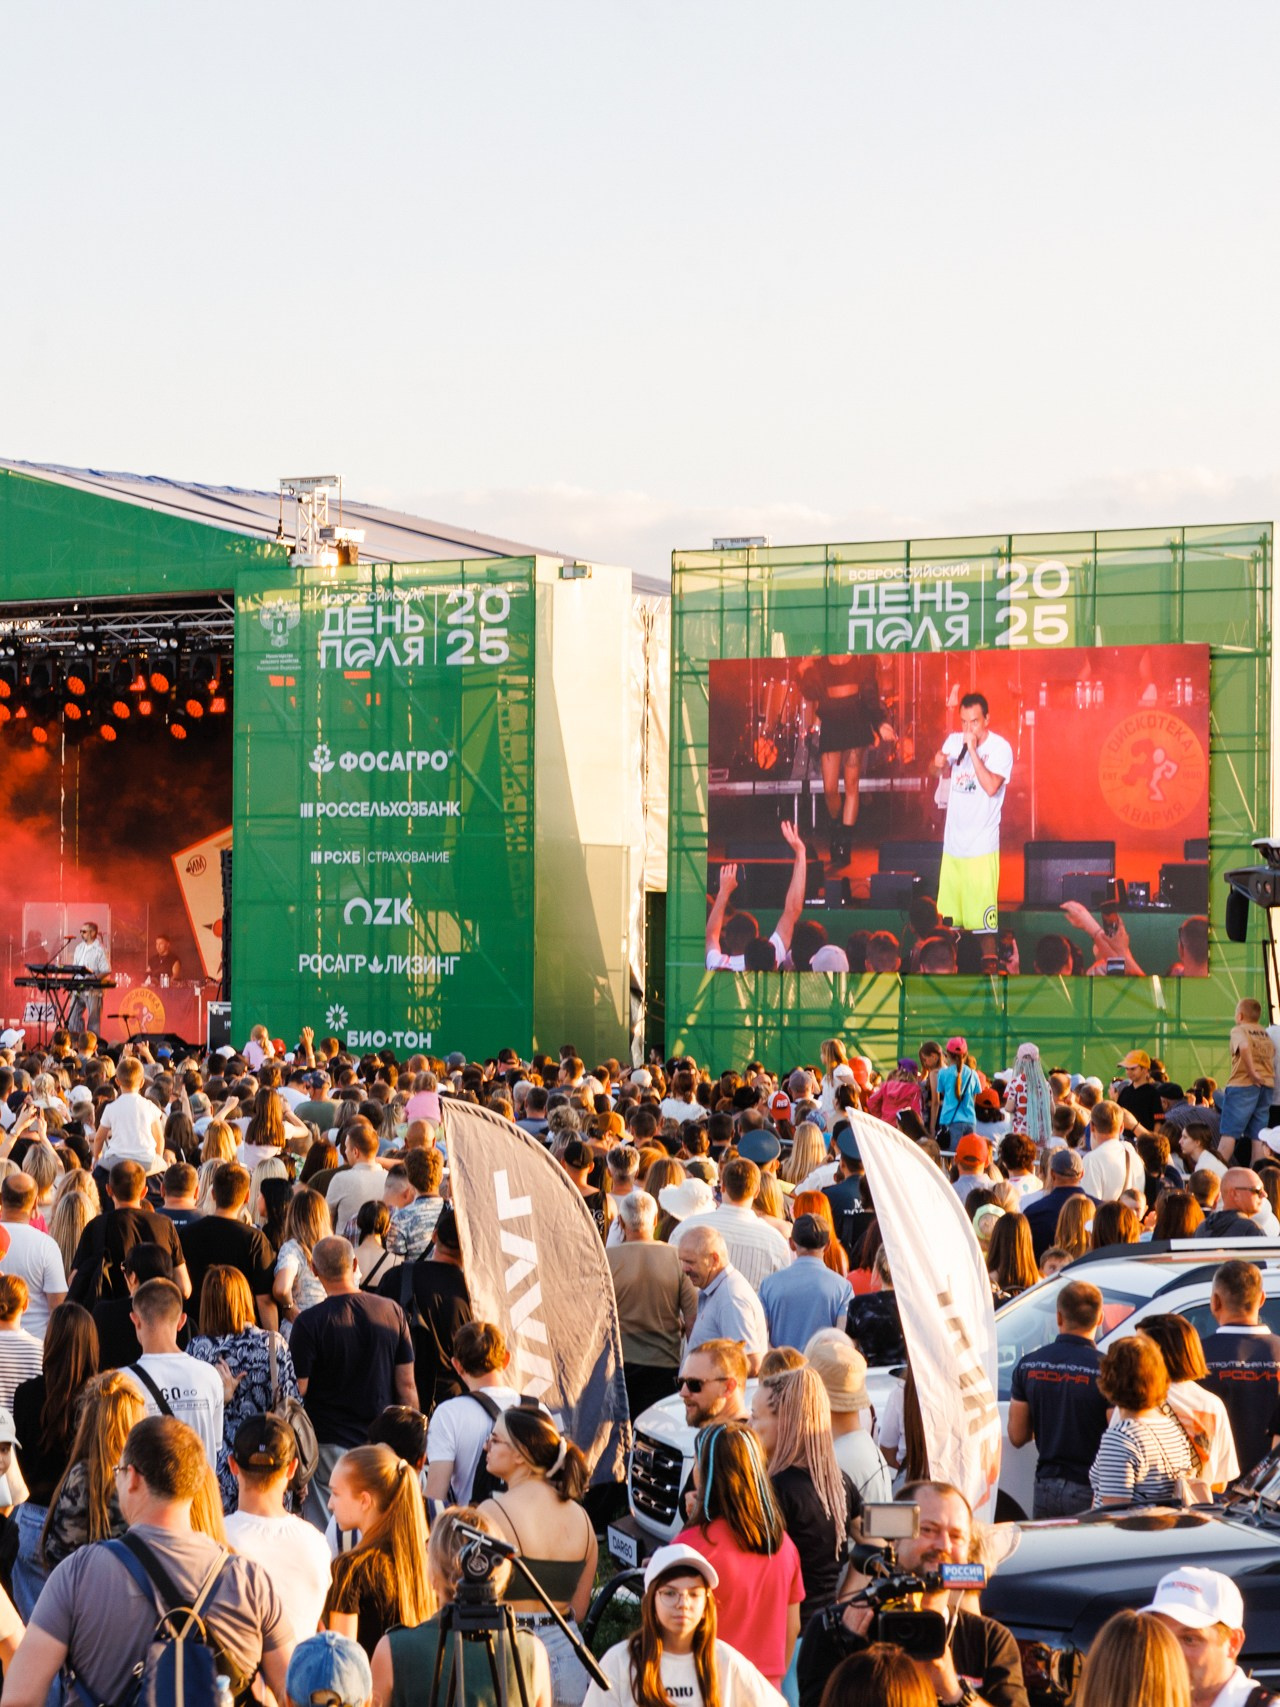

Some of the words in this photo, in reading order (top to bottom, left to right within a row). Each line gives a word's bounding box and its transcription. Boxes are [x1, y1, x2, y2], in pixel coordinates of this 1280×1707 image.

[848, 562, 970, 581] ВСЕРОССИЙСКИЙ
[996, 560, 1070, 601] 20
[446, 588, 511, 625] 20
[848, 580, 970, 616] ДЕНЬ
[321, 603, 425, 636] ДЕНЬ
[848, 614, 969, 650] ПОЛЯ
[995, 604, 1069, 647] 25
[320, 636, 424, 669] ПОЛЯ
[446, 628, 510, 665] 25
[339, 750, 448, 772] ФОСАГРО
[316, 801, 461, 818] РОССЕЛЬХОЗБАНК
[324, 851, 361, 864] РСХБ
[367, 851, 450, 863] СТРАХОВАНИЕ
[1219, 1370, 1280, 1381] РОДИН
[612, 1535, 633, 1559] DARGO
[944, 1564, 983, 1576] РОССИЯ
